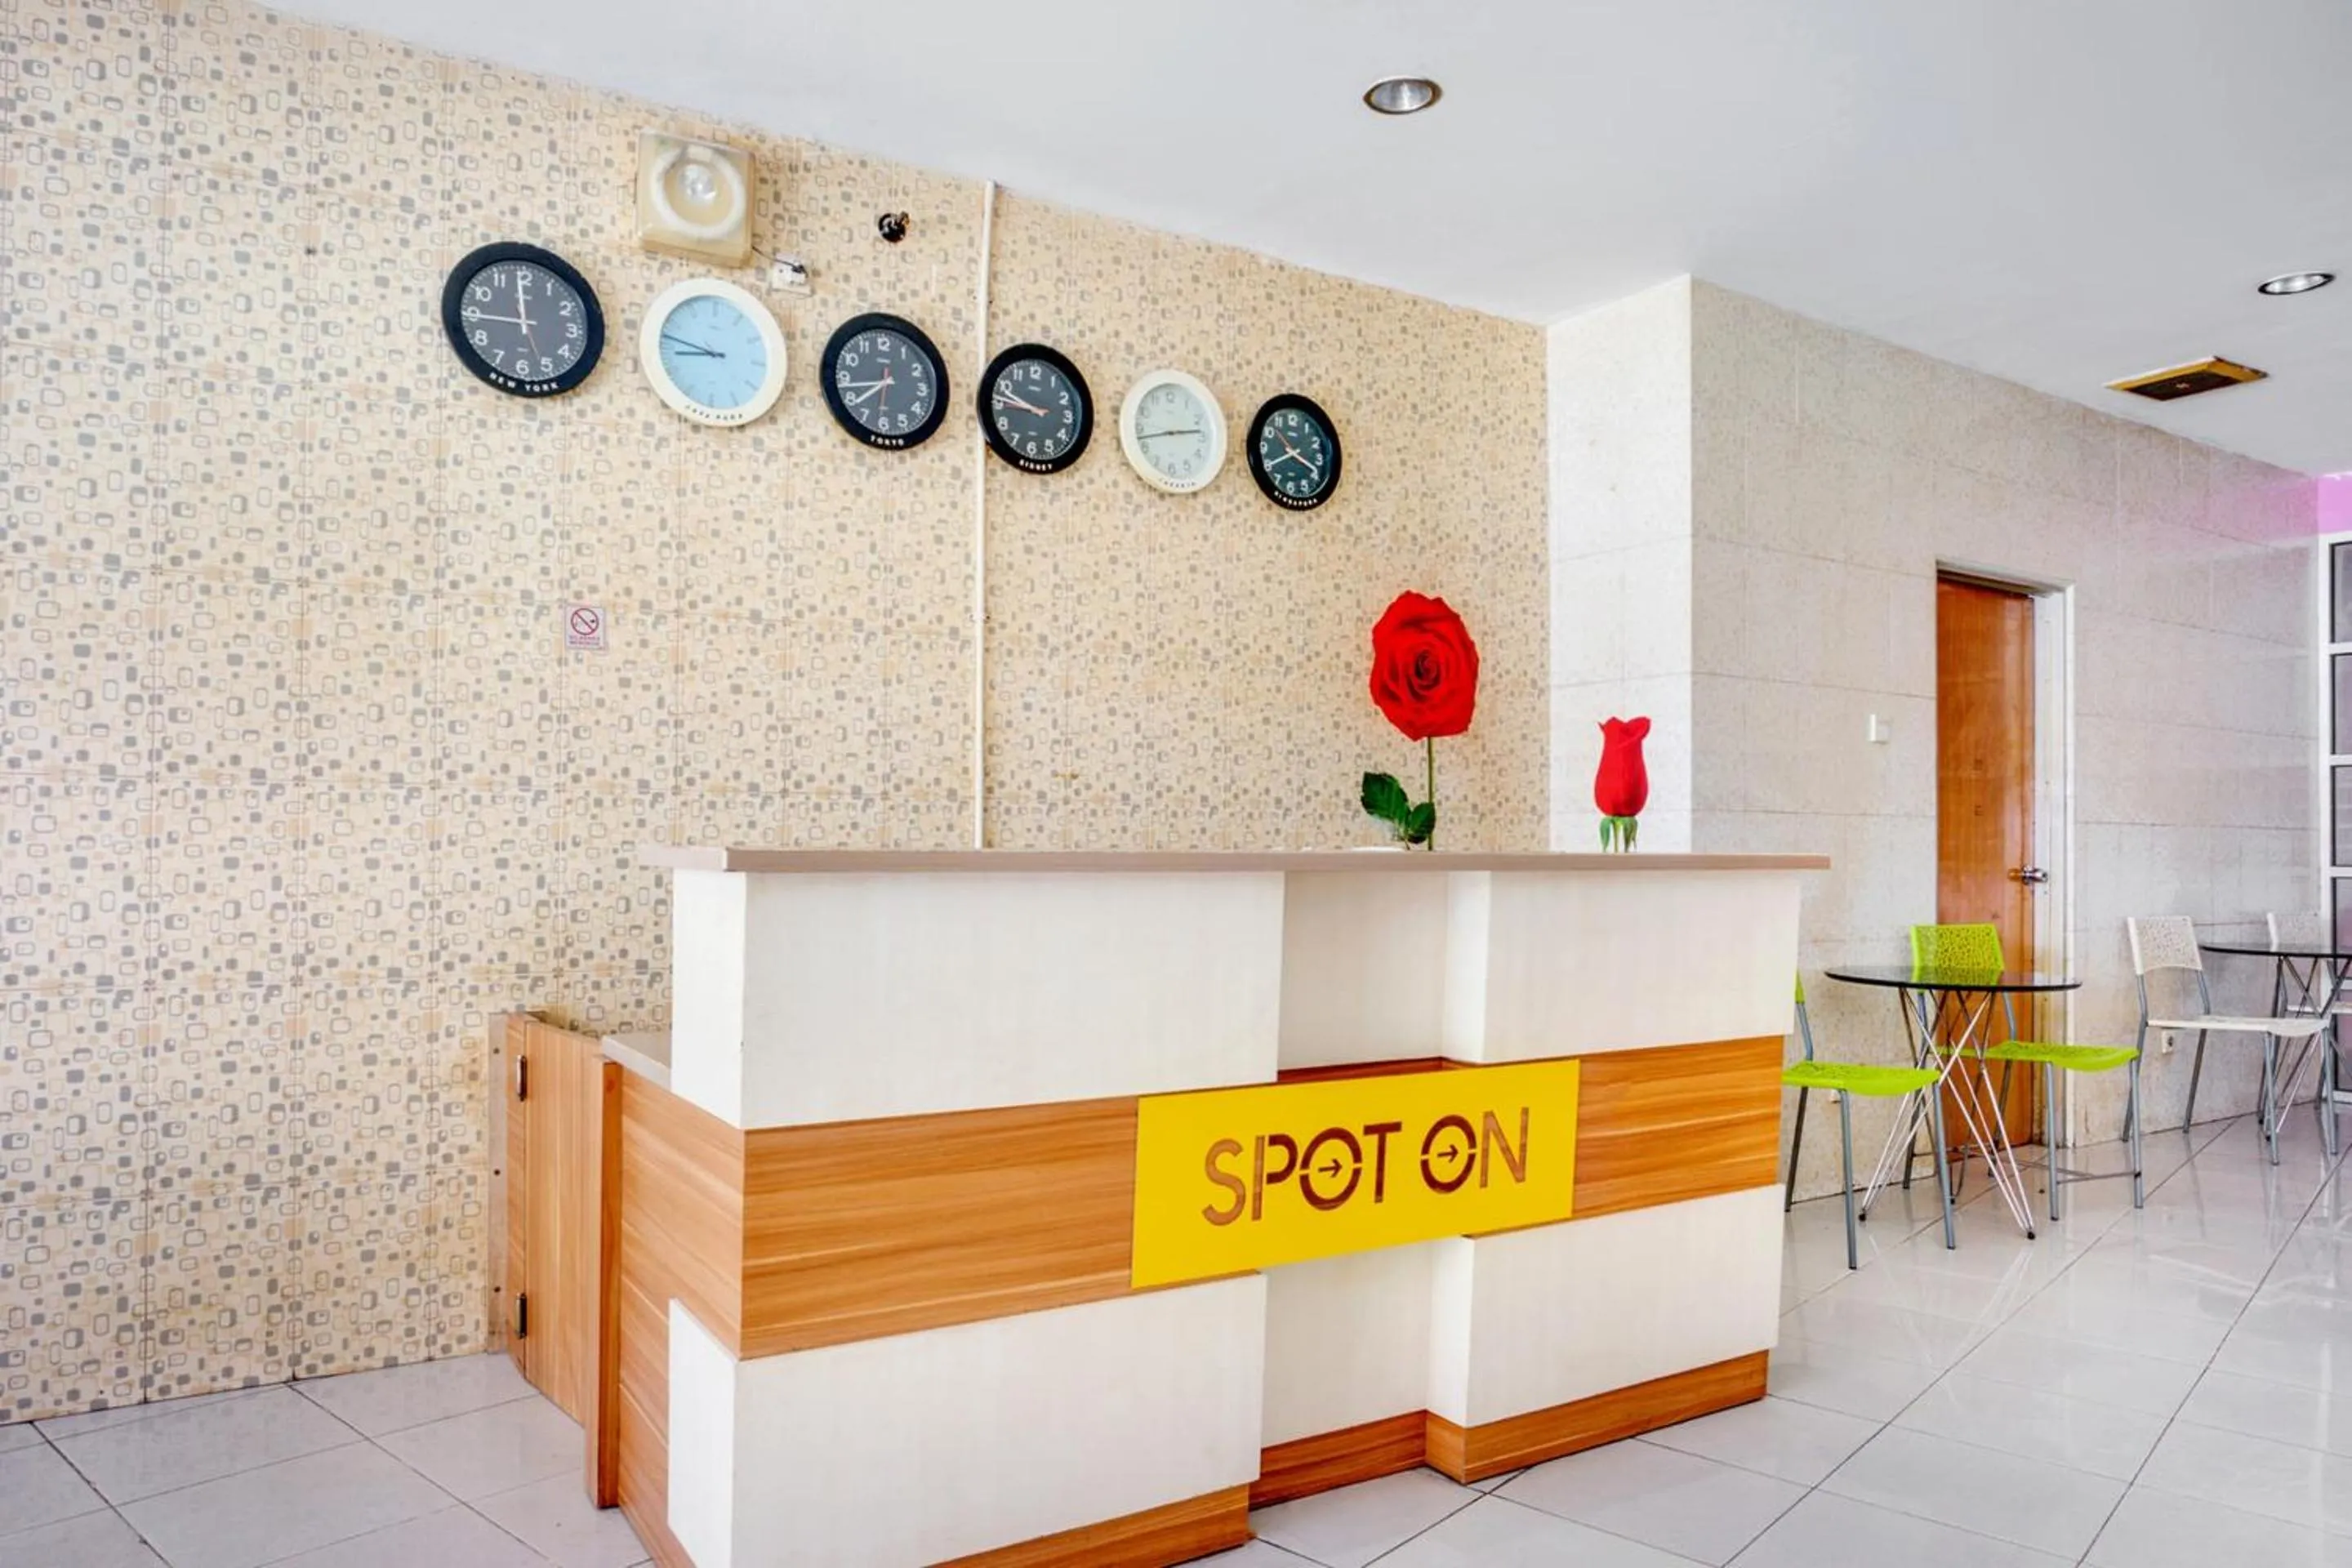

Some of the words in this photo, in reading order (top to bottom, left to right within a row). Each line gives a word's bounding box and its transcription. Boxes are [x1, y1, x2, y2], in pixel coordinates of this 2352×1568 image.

[493, 273, 506, 288] 11
[475, 286, 492, 301] 10
[546, 282, 552, 296] 1
[467, 306, 480, 322] 9
[559, 301, 572, 316] 2
[566, 323, 578, 338] 3
[474, 330, 488, 345] 8
[859, 340, 869, 354] 11
[878, 338, 890, 351] 12
[492, 349, 506, 364] 7
[558, 344, 570, 359] 4
[901, 346, 906, 359] 1
[540, 357, 554, 372] 5
[845, 353, 858, 367] 10
[516, 359, 530, 375] 6
[911, 363, 921, 376] 2
[1031, 366, 1041, 380] 12
[840, 371, 850, 386] 9
[1013, 368, 1022, 381] 11
[525, 381, 559, 392] YORK
[1000, 380, 1012, 392] 10
[1050, 376, 1056, 389] 1
[916, 383, 927, 396] 3
[845, 392, 856, 406] 8
[1059, 392, 1068, 405] 2
[860, 408, 869, 421] 7
[911, 402, 920, 414] 4
[879, 416, 889, 430] 6
[898, 413, 908, 427] 5
[998, 416, 1008, 430] 8
[1063, 411, 1073, 424] 3
[1275, 415, 1282, 427] 11
[1288, 414, 1298, 426] 12
[1011, 433, 1019, 446] 7
[1057, 428, 1066, 440] 4
[1027, 442, 1036, 455] 6
[1044, 439, 1054, 452] 5
[1260, 441, 1267, 454] 9
[1312, 438, 1320, 449] 2
[1264, 459, 1272, 472] 8
[1315, 453, 1322, 466] 3
[1274, 473, 1282, 485] 7
[1286, 481, 1294, 492] 6
[1201, 1121, 1402, 1226] SPOT
[1419, 1107, 1530, 1194] ON
